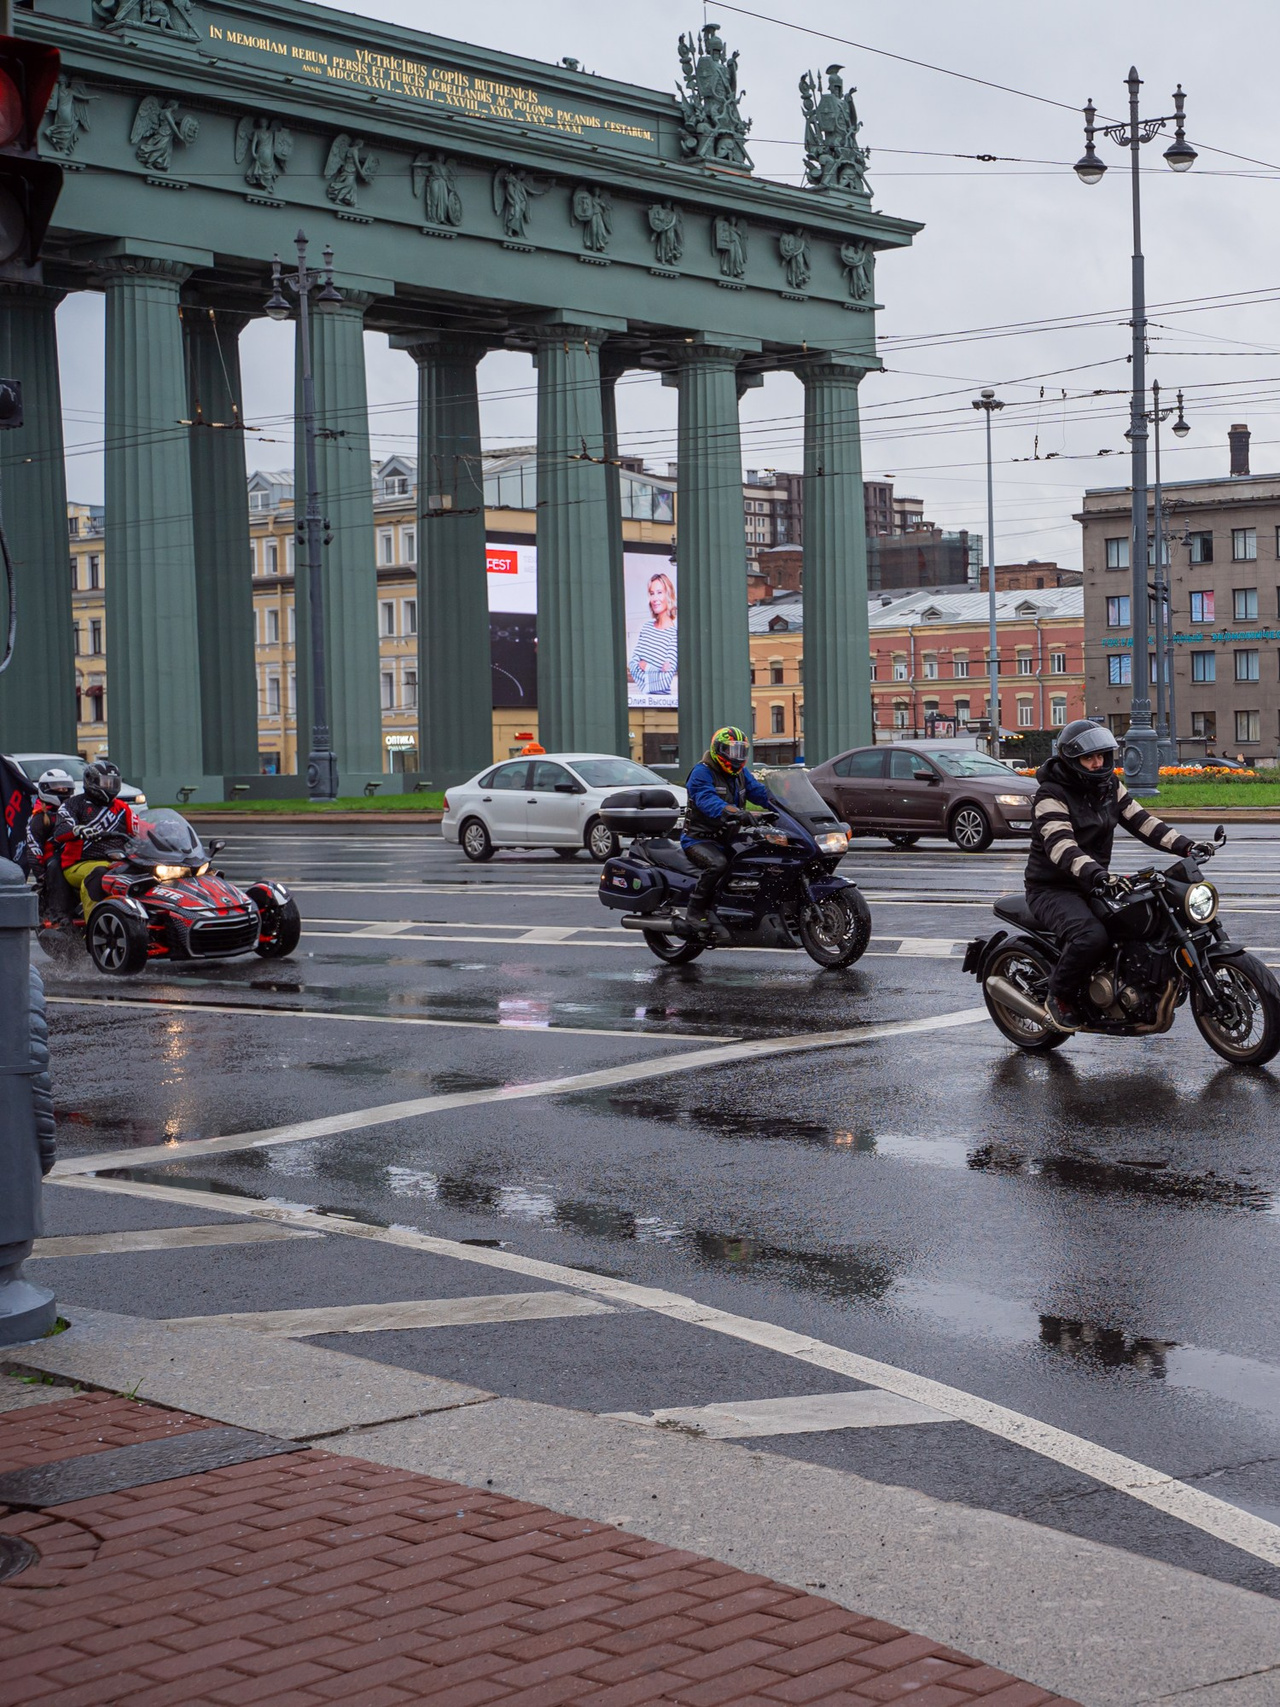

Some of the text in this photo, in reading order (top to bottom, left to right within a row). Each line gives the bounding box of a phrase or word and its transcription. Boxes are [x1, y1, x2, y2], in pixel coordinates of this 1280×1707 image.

[209, 25, 222, 39] IN
[226, 31, 287, 55] MEMORIAM
[292, 46, 327, 65] RERUM
[332, 56, 368, 74] PERSIS
[371, 66, 385, 78] ET
[389, 70, 425, 88] TURCIS
[428, 79, 492, 103] DEBELLANDIS
[496, 96, 509, 107] AC
[514, 100, 553, 118] POLONIS
[557, 110, 600, 128] PACANDIS
[355, 49, 538, 103] VICTRICIBUS COPIIS RUTHENICIS
[486, 558, 511, 570] FEST
[385, 735, 415, 745] ОПТИКА
